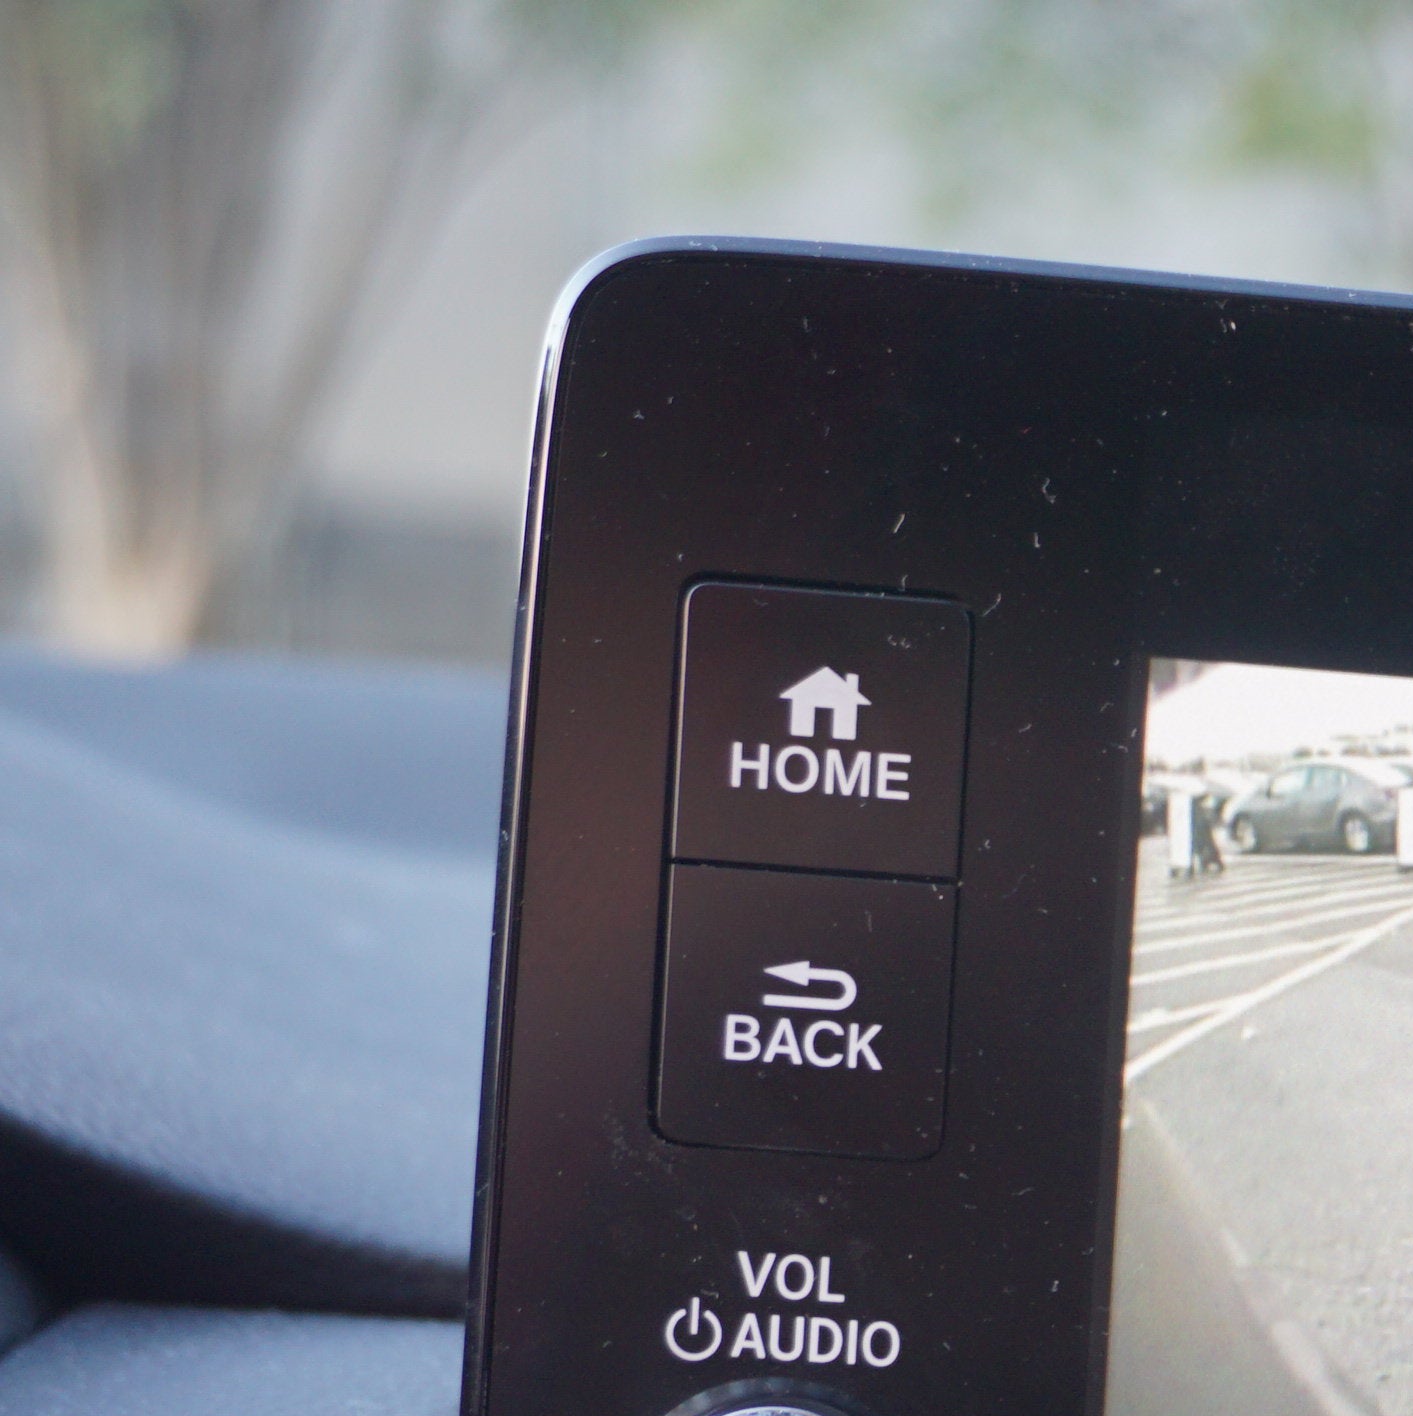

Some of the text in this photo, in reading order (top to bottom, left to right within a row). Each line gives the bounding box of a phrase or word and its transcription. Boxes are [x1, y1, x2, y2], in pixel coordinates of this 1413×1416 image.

[728, 740, 912, 802] HOME
[722, 1012, 884, 1072] BACK
[736, 1249, 846, 1305] VOL
[729, 1311, 902, 1369] AUDIO
